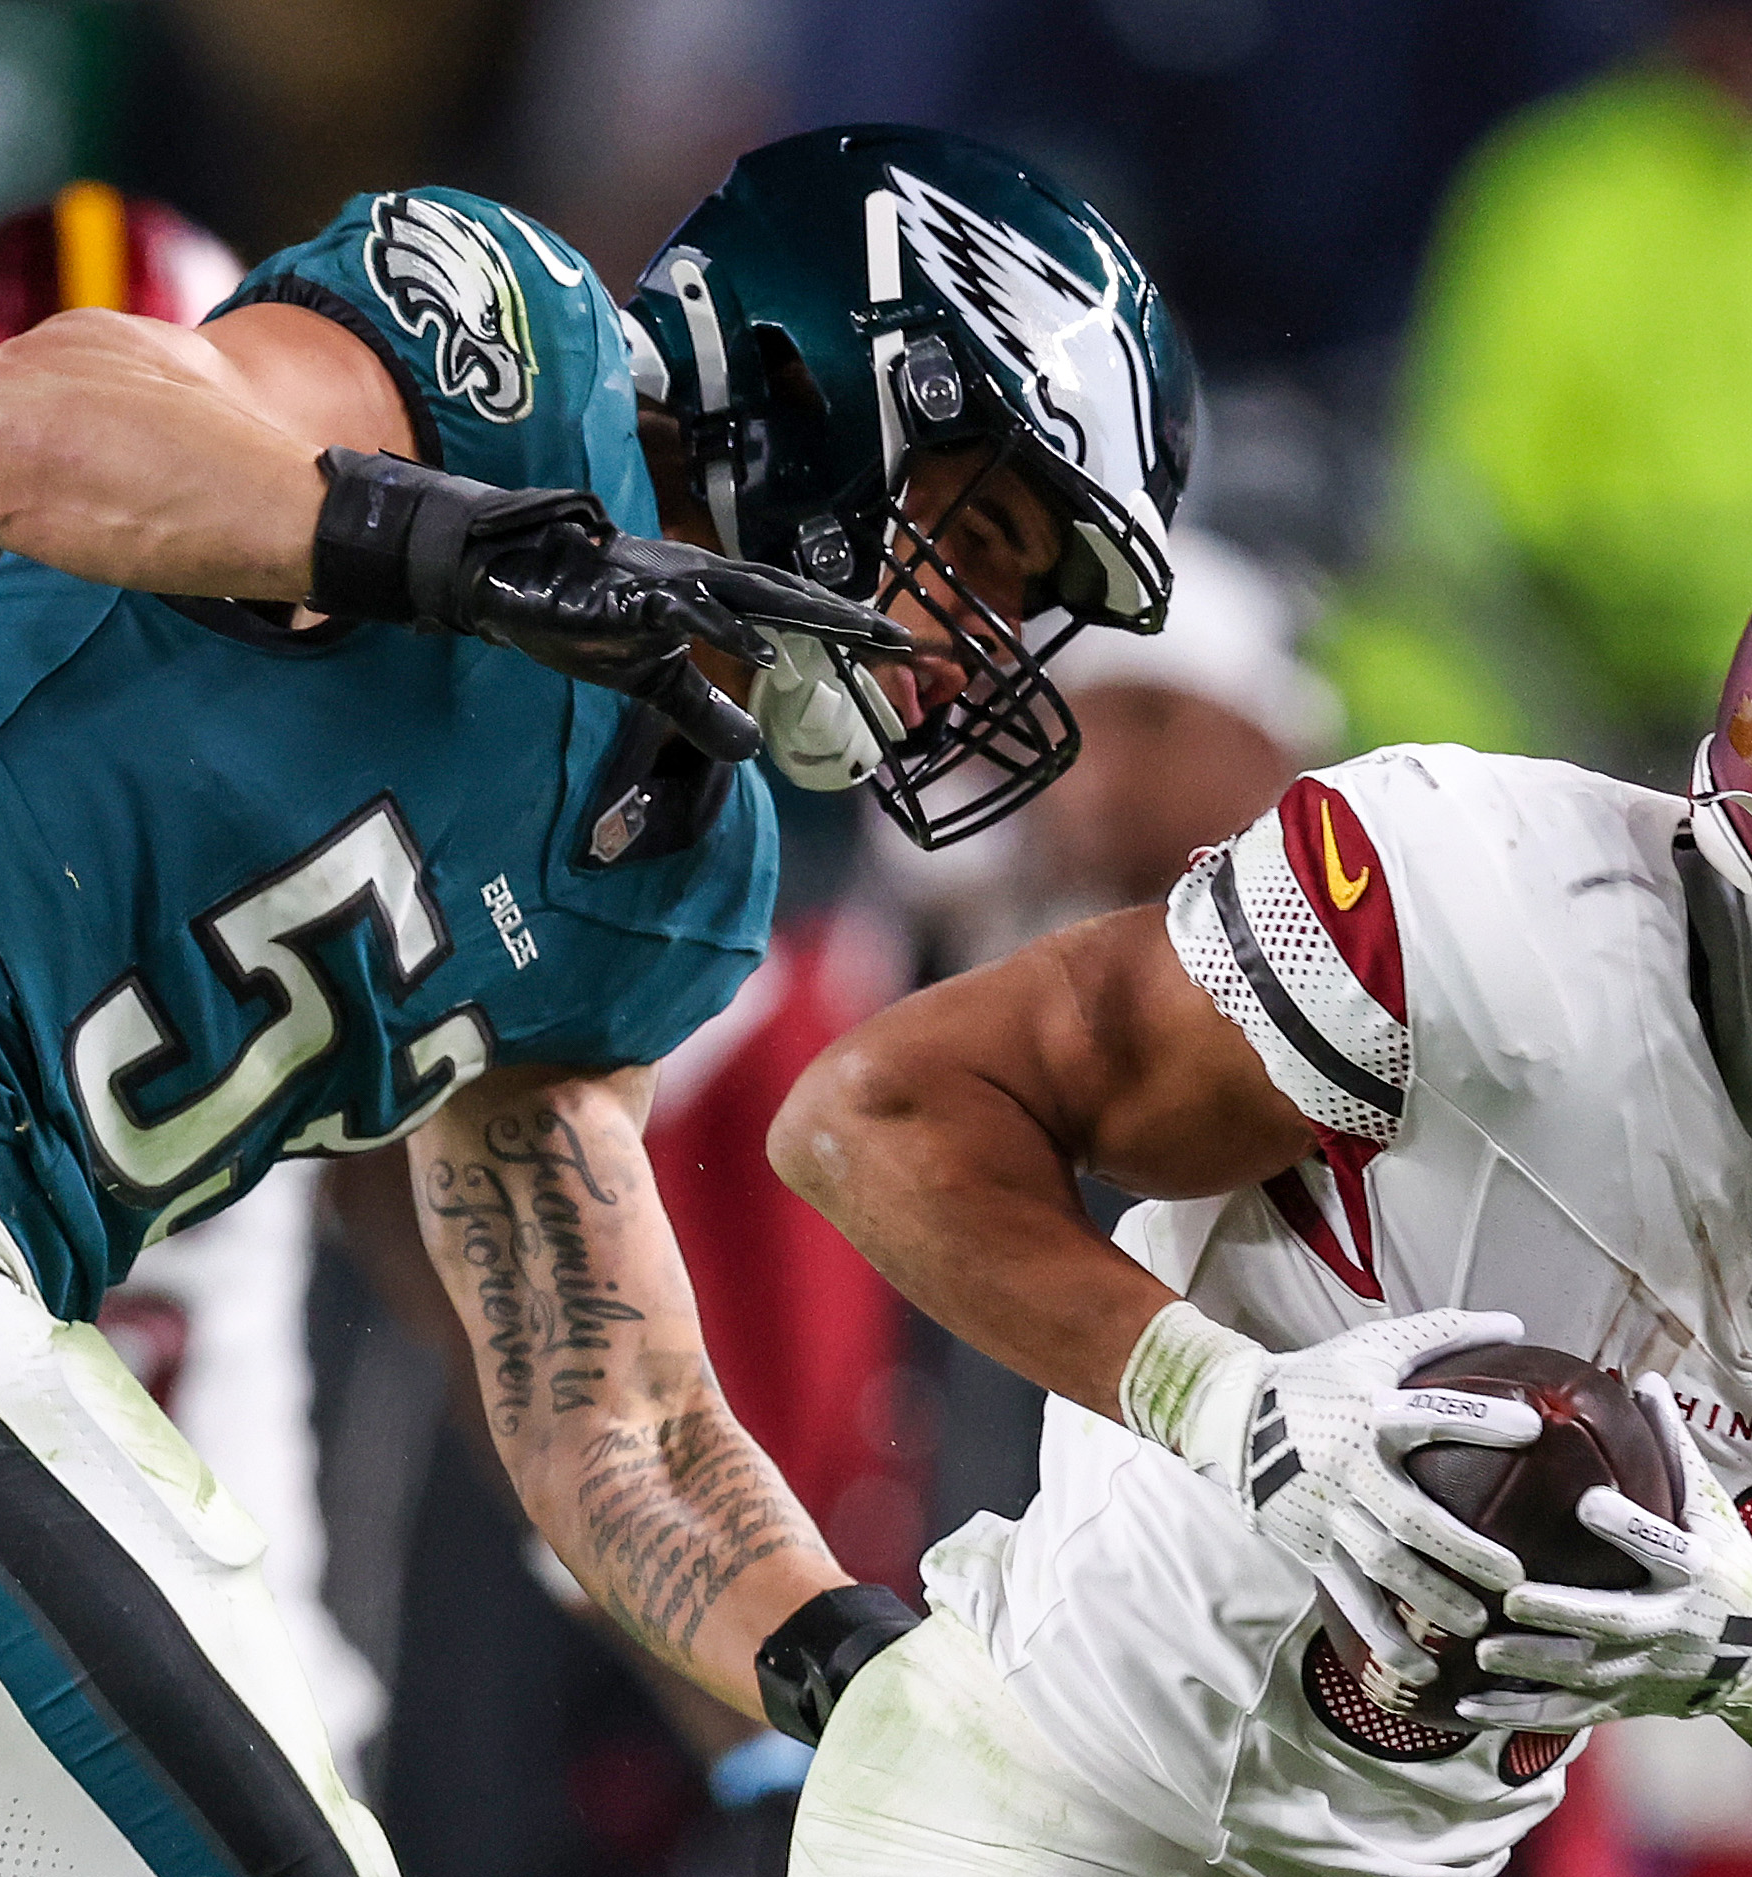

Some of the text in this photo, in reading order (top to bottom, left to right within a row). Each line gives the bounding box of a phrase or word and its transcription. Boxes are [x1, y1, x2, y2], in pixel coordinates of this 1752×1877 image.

[479, 871, 541, 971] EAGLES
[426, 1159, 539, 1437] Forever
[485, 1111, 646, 1355] Family
